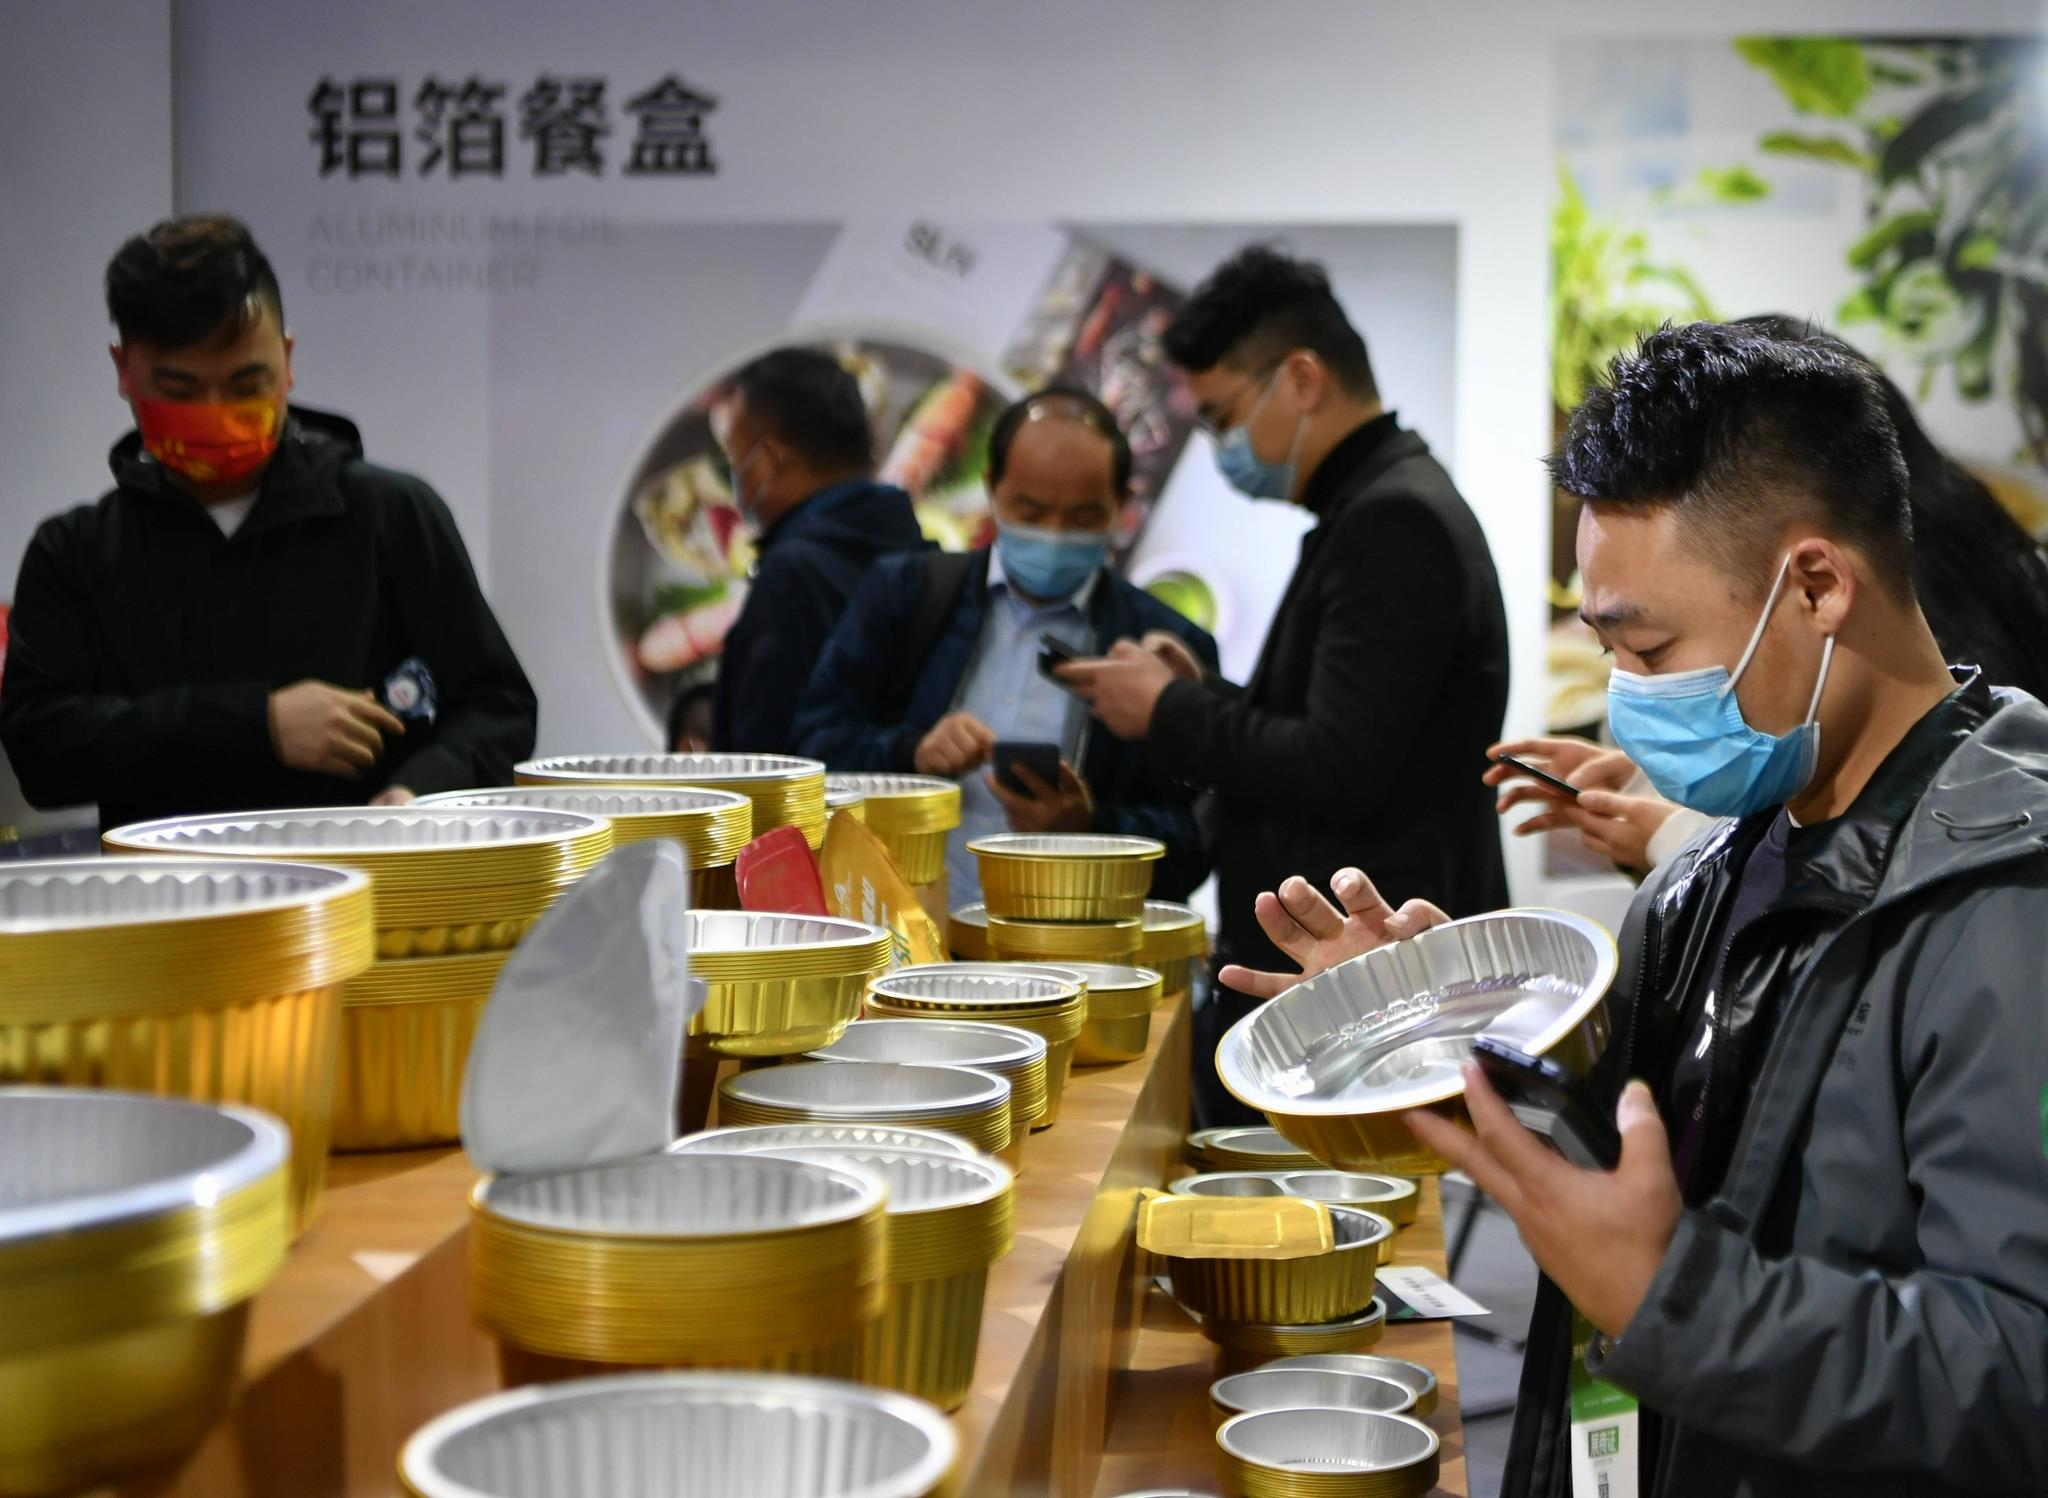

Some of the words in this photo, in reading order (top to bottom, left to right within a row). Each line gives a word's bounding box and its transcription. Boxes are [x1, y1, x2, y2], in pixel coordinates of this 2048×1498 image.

[308, 74, 718, 178] 铝箔餐盒
[307, 254, 540, 295] CONTAINER
